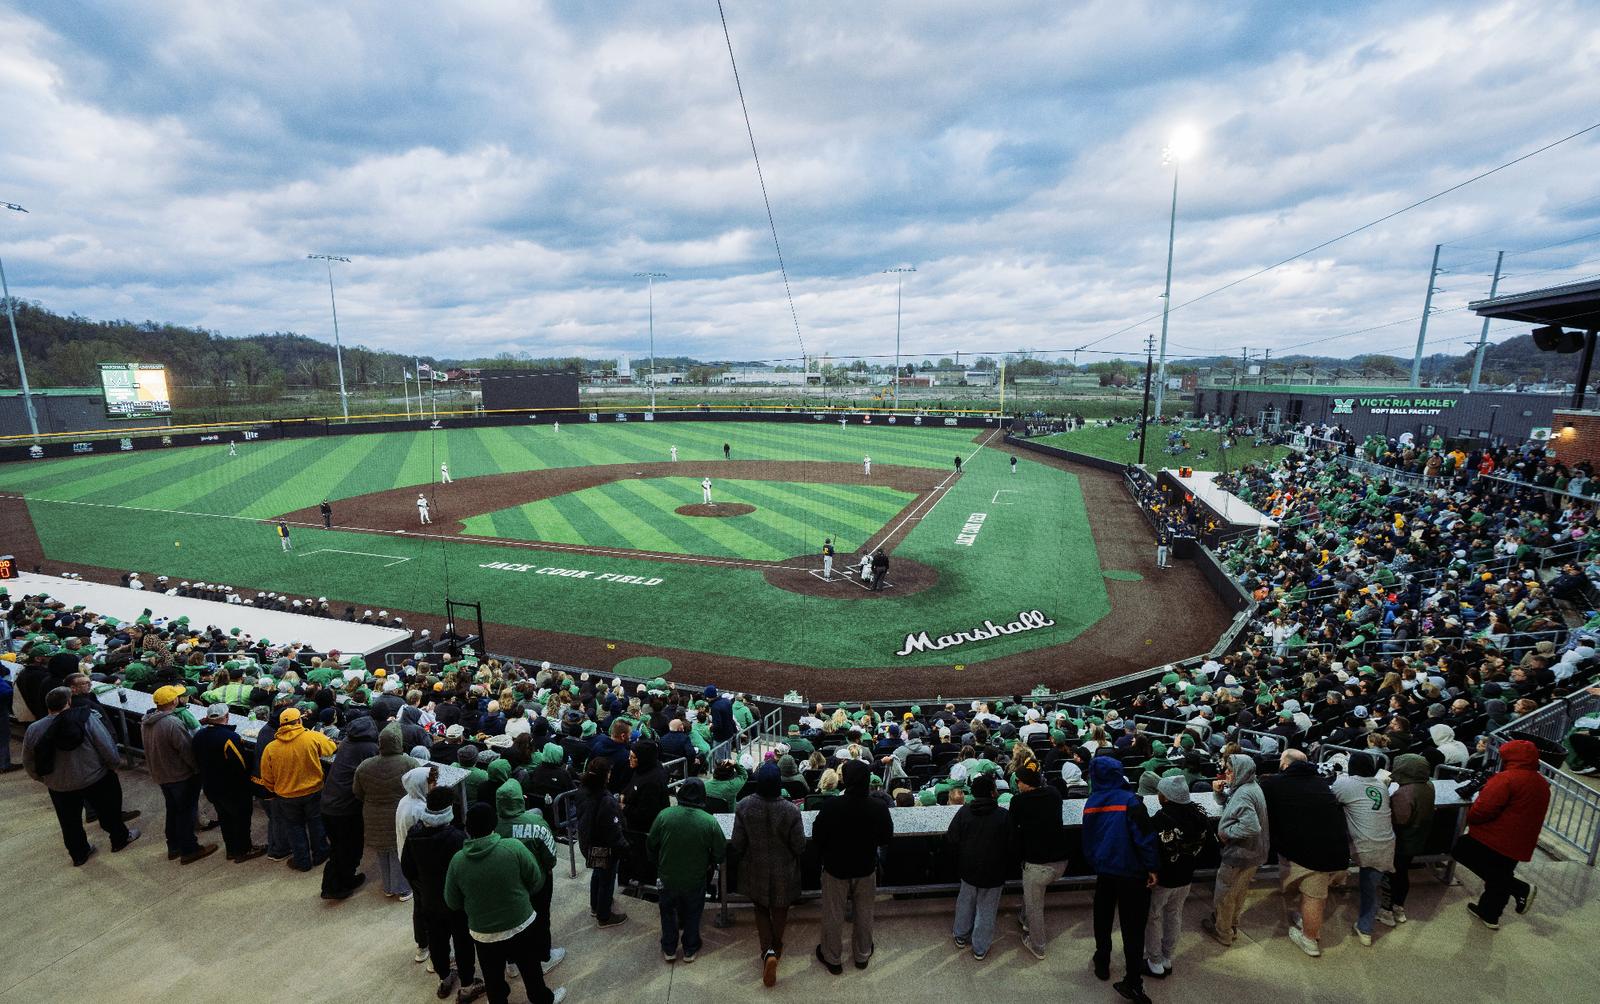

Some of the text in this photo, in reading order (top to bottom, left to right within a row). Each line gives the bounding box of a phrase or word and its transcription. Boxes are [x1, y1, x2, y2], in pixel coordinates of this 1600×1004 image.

[1359, 398, 1458, 408] VICTORIA FARLEY
[479, 561, 664, 586] JACK COOK FIELD
[895, 609, 1056, 656] Marshall
[1366, 786, 1382, 810] 9
